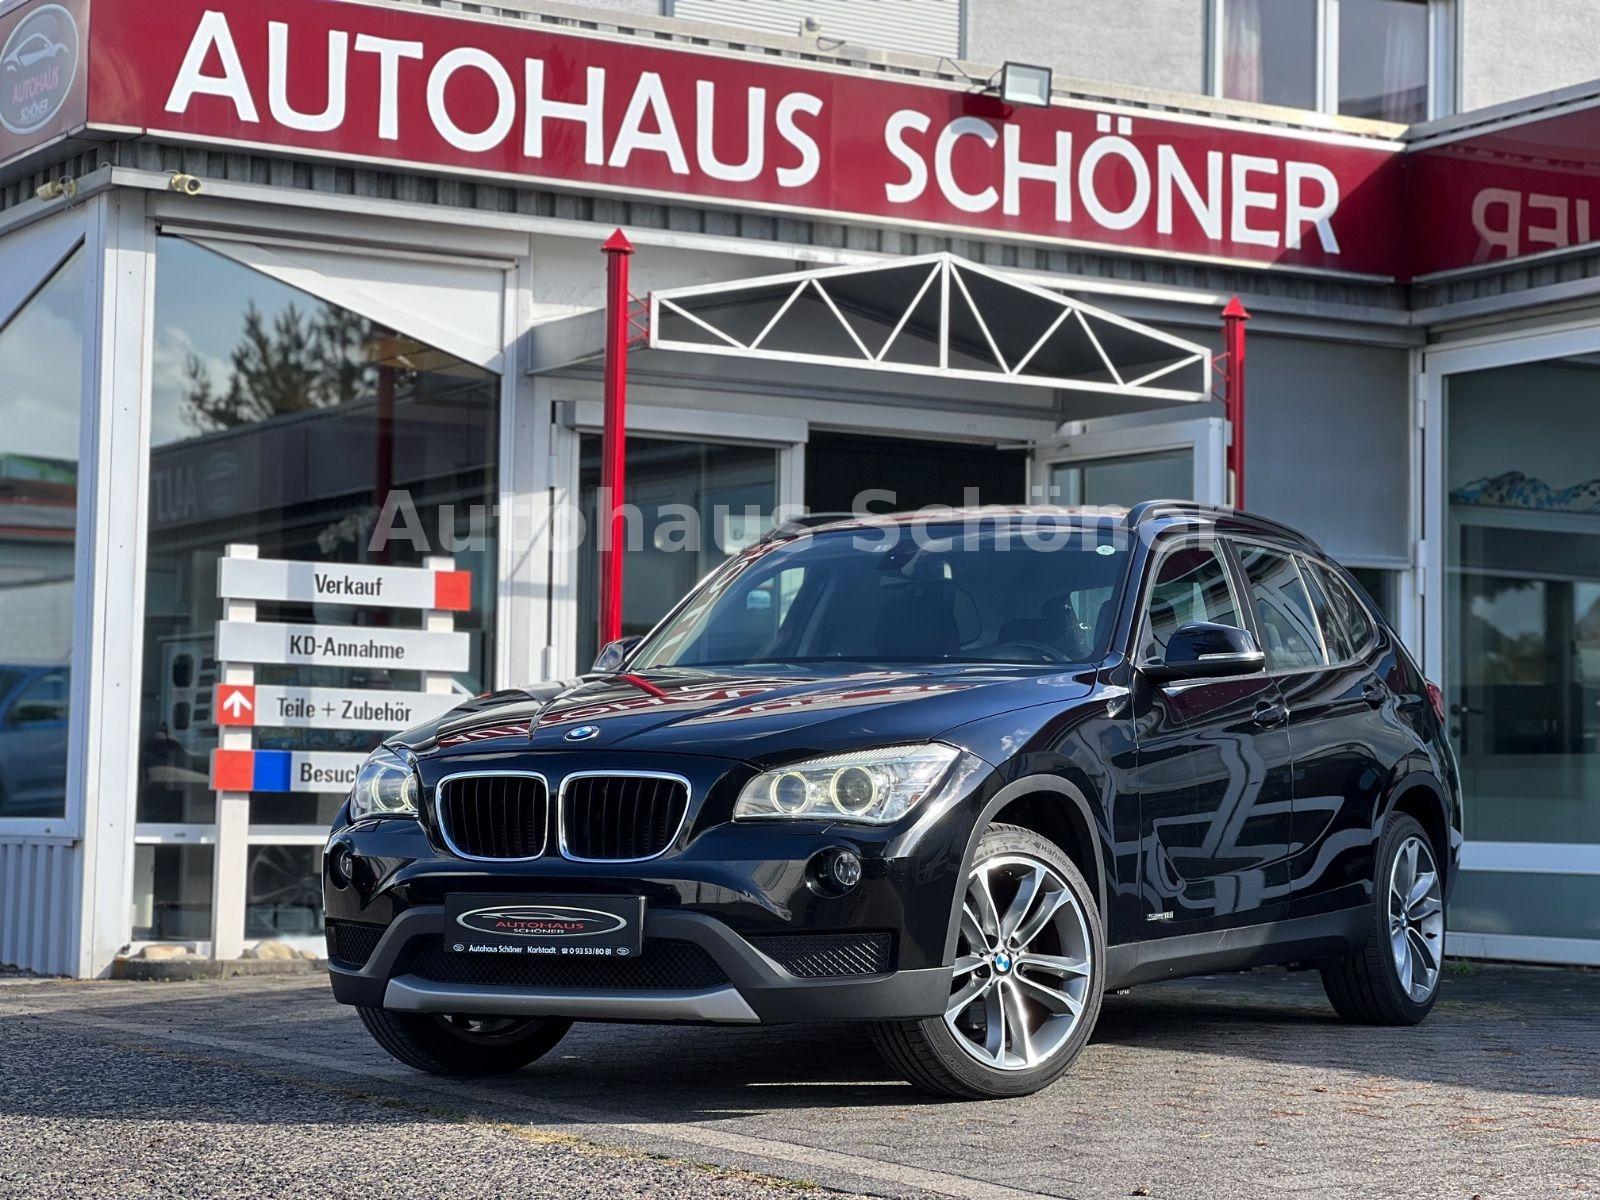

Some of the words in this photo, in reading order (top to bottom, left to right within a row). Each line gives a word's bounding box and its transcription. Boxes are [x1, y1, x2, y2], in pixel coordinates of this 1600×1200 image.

[12, 65, 60, 104] AUTOHAUS
[164, 9, 825, 189] AUTOHAUS
[884, 108, 1341, 255] SCHÖNER
[314, 573, 383, 597] Verkauf
[289, 634, 405, 660] KD-Annahme
[276, 697, 316, 719] Teile
[341, 700, 413, 722] Zubehör
[495, 921, 584, 929] AUTOHAUS
[468, 944, 498, 952] Autohaus
[498, 945, 523, 953] Schöner
[527, 945, 557, 954] Karlstadt
